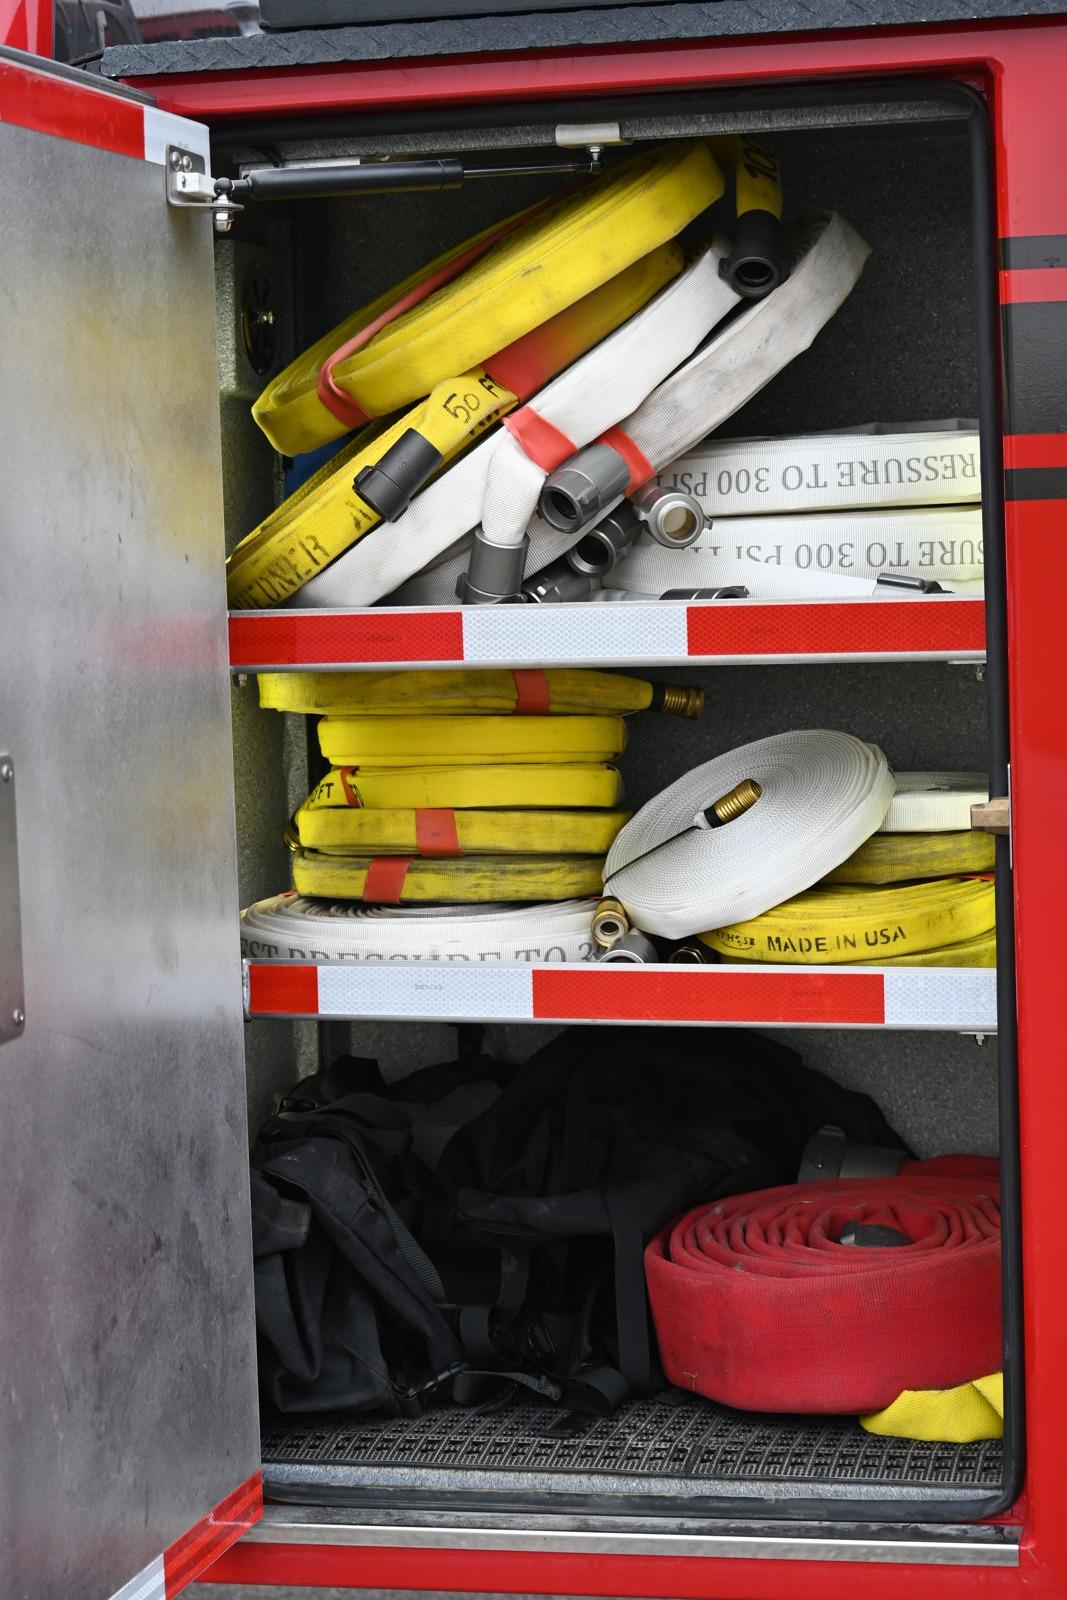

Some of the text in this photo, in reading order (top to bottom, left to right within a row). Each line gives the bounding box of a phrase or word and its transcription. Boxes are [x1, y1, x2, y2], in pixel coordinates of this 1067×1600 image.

[443, 393, 480, 424] 50
[717, 467, 770, 496] 300
[782, 463, 828, 491] TO
[837, 453, 977, 488] RESSURE
[795, 542, 854, 569] 300
[866, 541, 909, 568] TO
[767, 934, 828, 953] MADE
[836, 933, 857, 950] IN
[864, 926, 907, 947] USA
